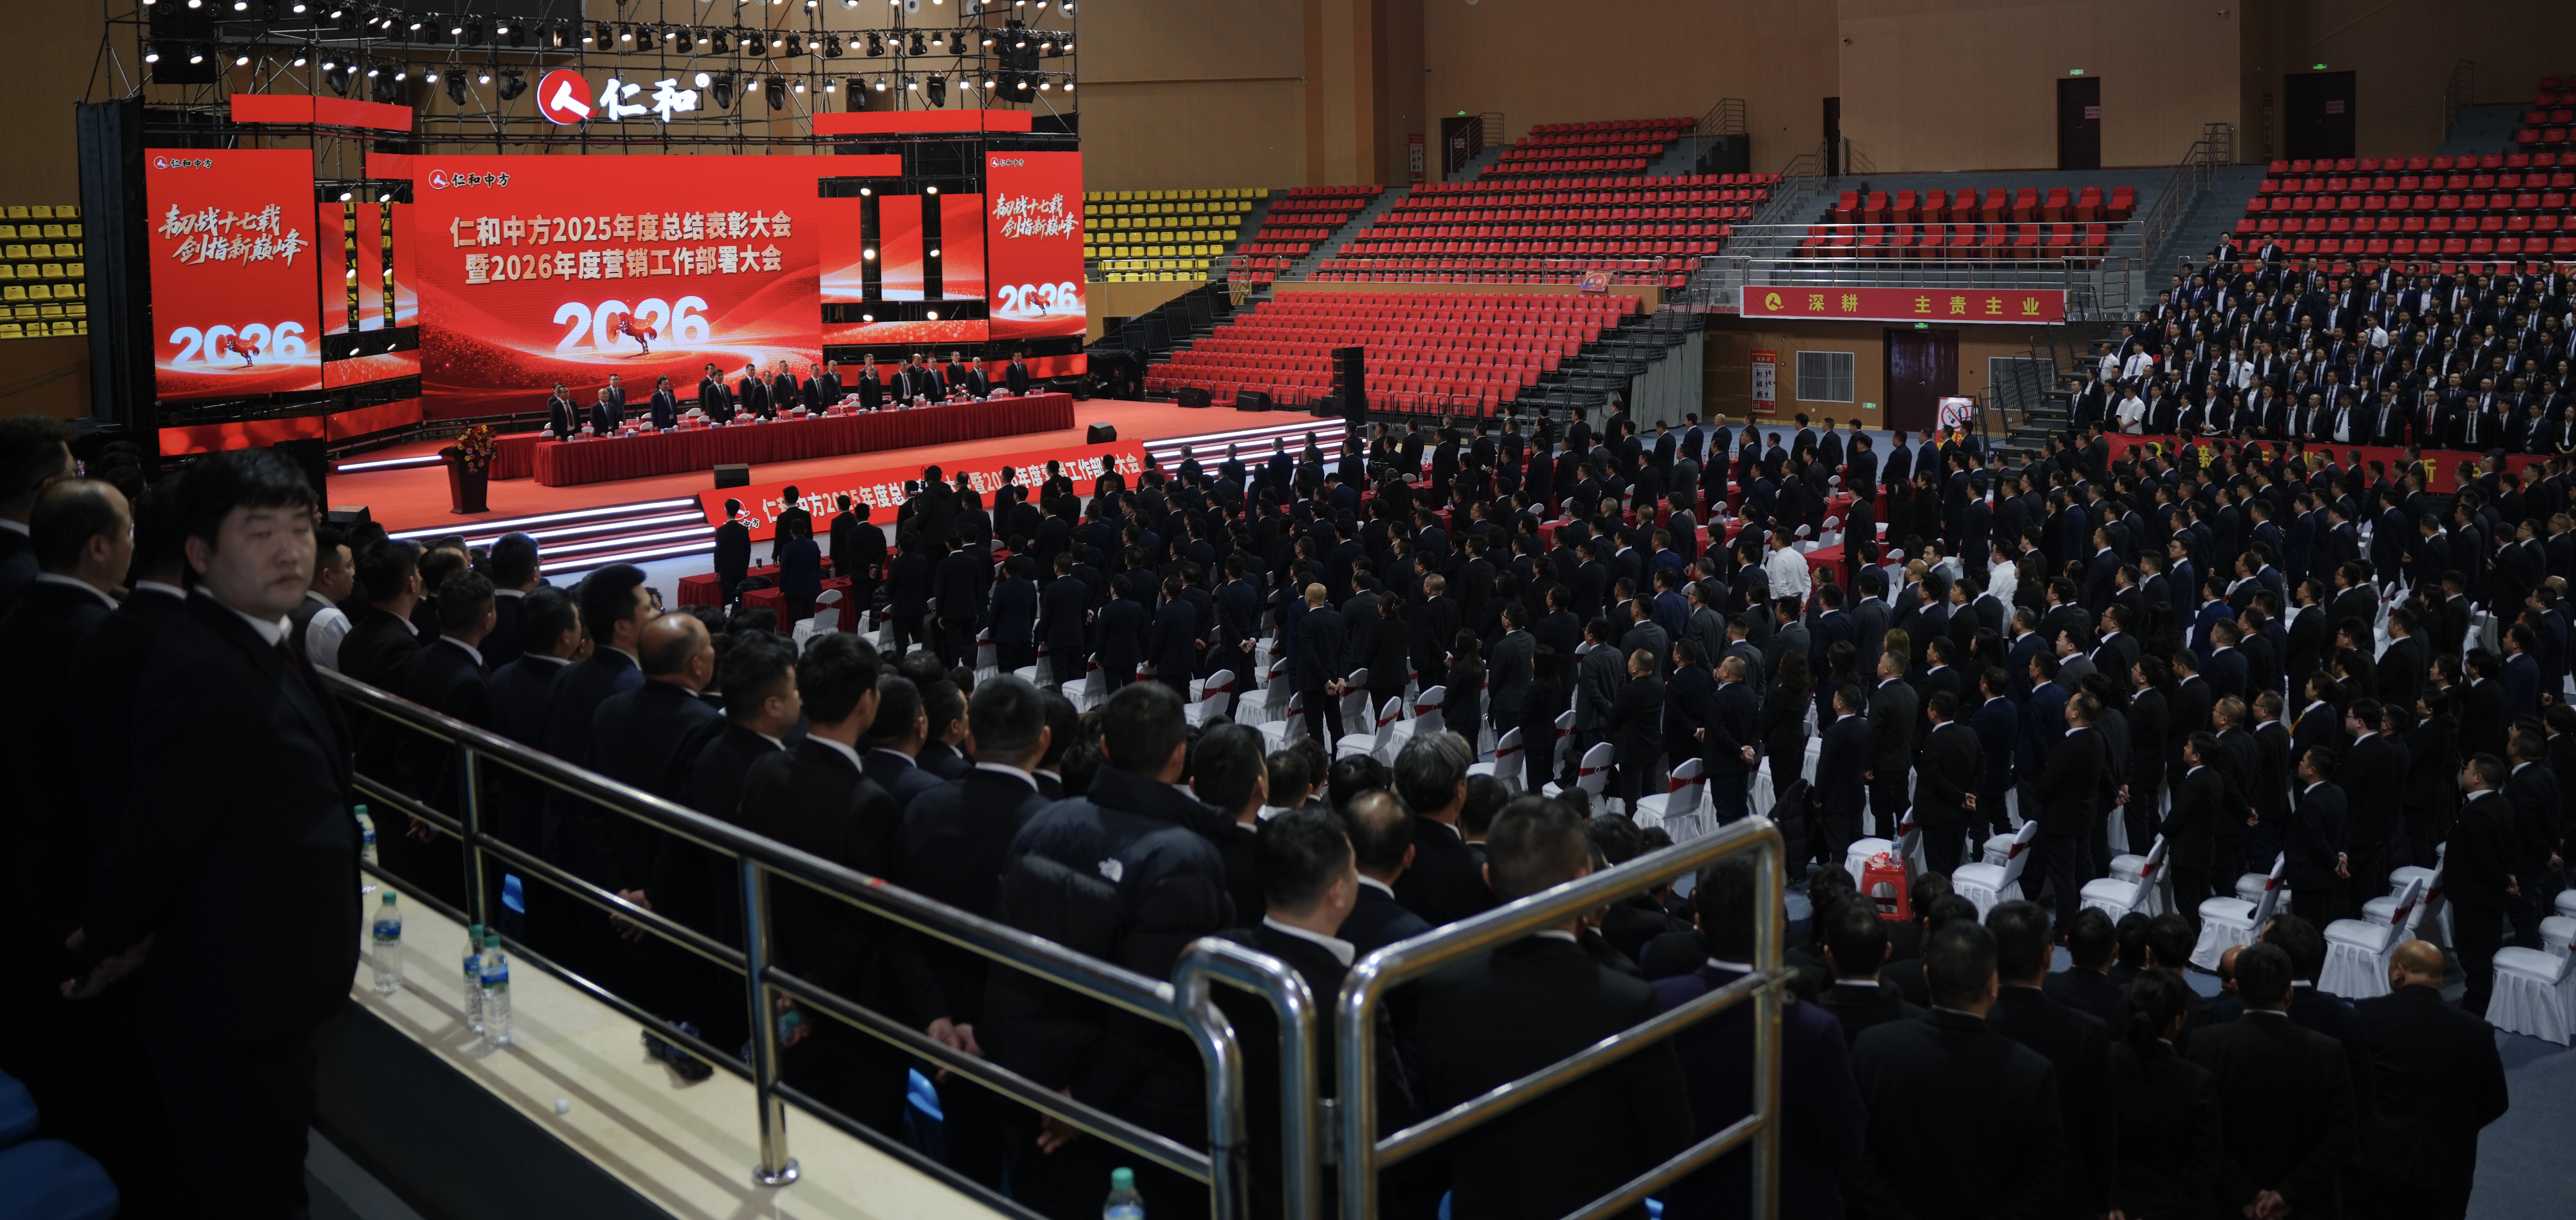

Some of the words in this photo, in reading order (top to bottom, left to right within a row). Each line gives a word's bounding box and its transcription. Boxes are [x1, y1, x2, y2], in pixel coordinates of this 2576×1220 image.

[600, 78, 697, 122] 仁和
[170, 158, 212, 169] 仁和中方
[452, 172, 510, 188] 仁和中方
[1000, 159, 1024, 167] 仁和中方
[158, 204, 280, 239] 韧战十七载
[992, 193, 1063, 219] 韧战十七载
[450, 210, 792, 247] 仁和中方2025年度总结表彰大会
[1000, 212, 1079, 241] 剑指新巅峰
[172, 229, 308, 268] 剑指新巅峰
[465, 244, 782, 285] 暨2026年度营销工作部署大会
[998, 282, 1077, 315] 2026
[1808, 294, 1858, 312] 深耕
[1914, 296, 2040, 315] 主责主业
[553, 296, 709, 353] 2026
[169, 321, 306, 366] 2026
